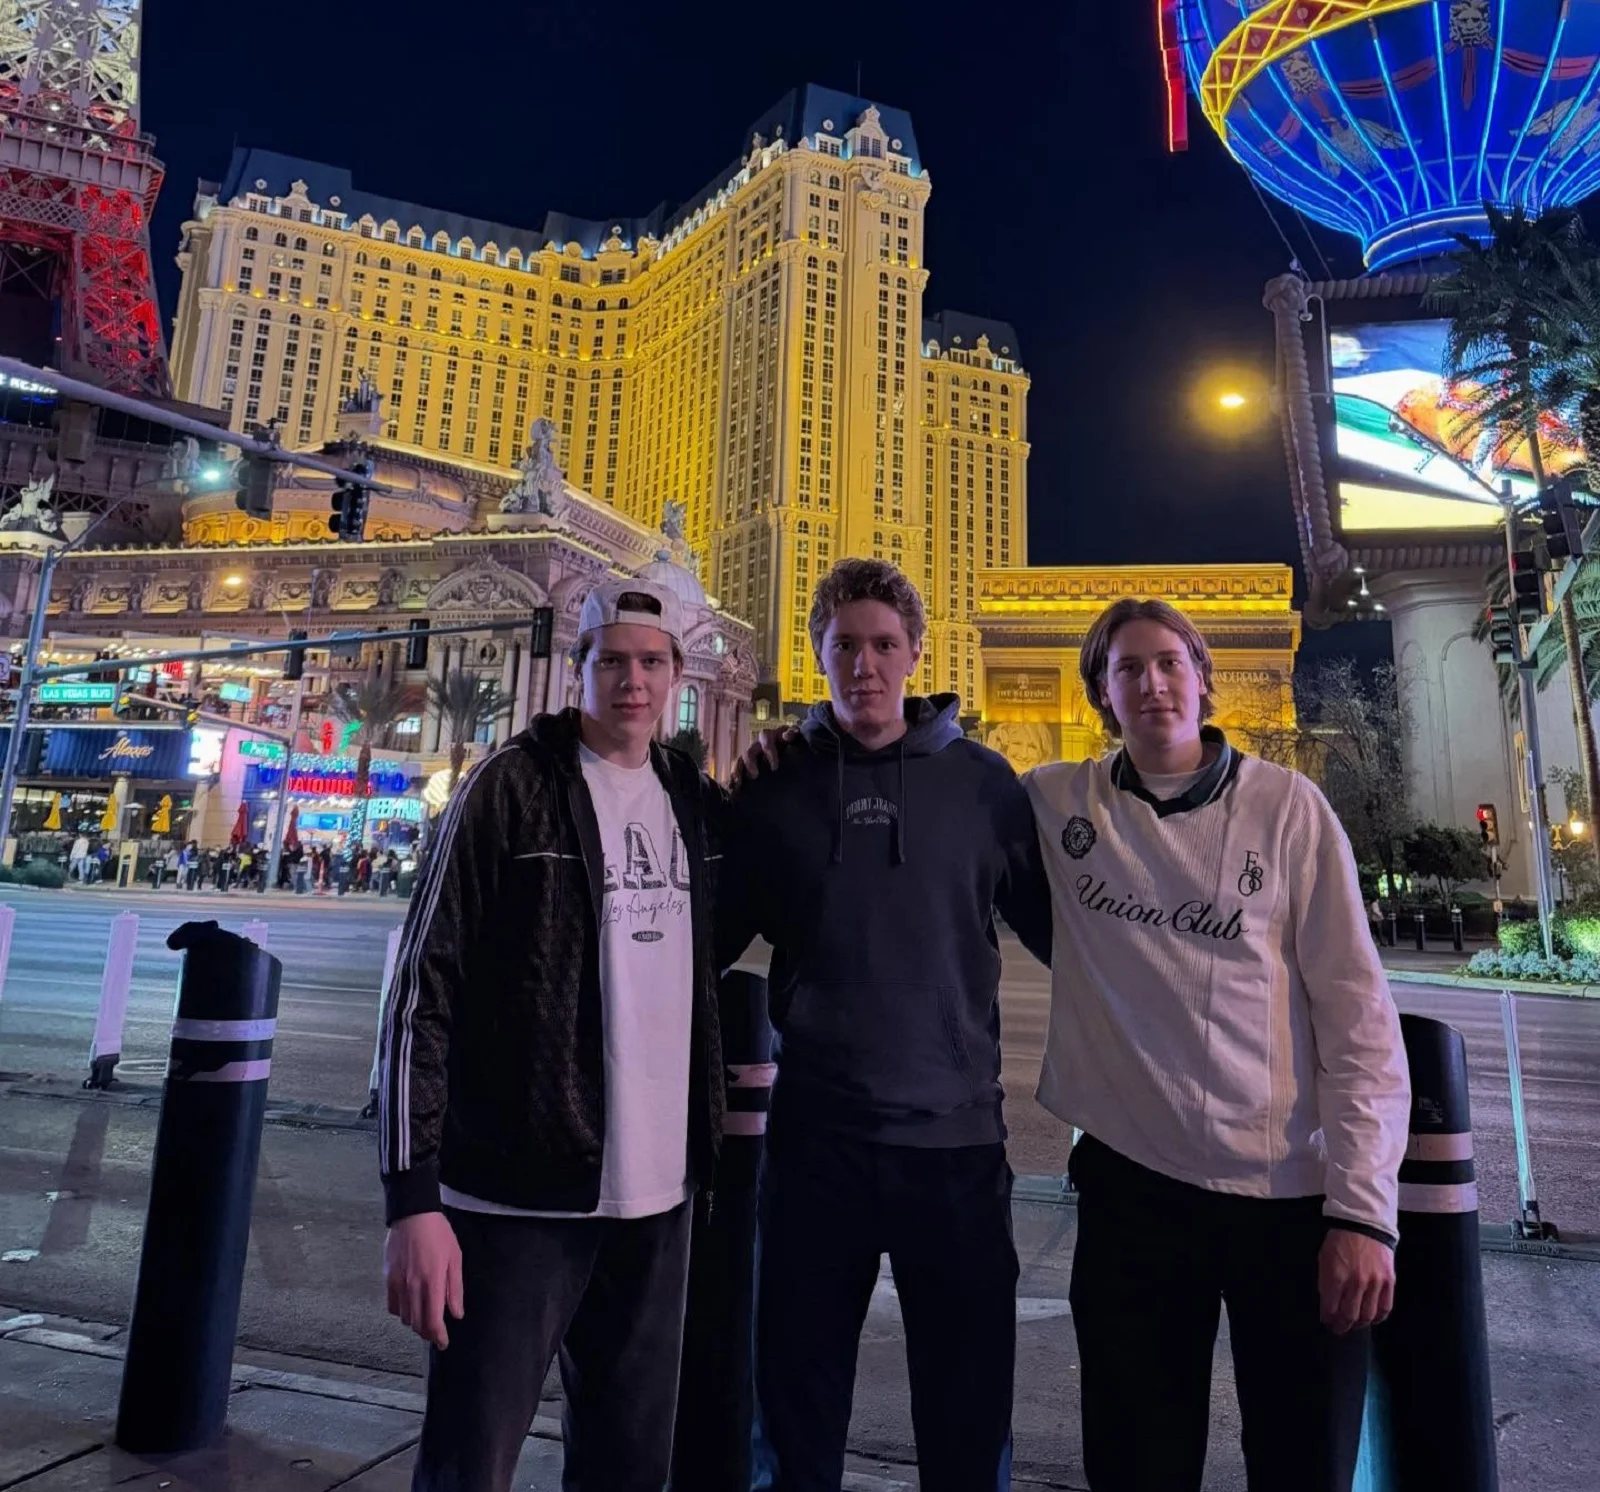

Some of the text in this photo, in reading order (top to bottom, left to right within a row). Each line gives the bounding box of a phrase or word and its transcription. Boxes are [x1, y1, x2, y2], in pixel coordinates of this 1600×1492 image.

[1213, 671, 1270, 684] NDERPUMP
[42, 688, 112, 699] LAS VEGAS BLVD
[600, 892, 687, 928] Los Angeles
[1076, 874, 1249, 940] Union Club
